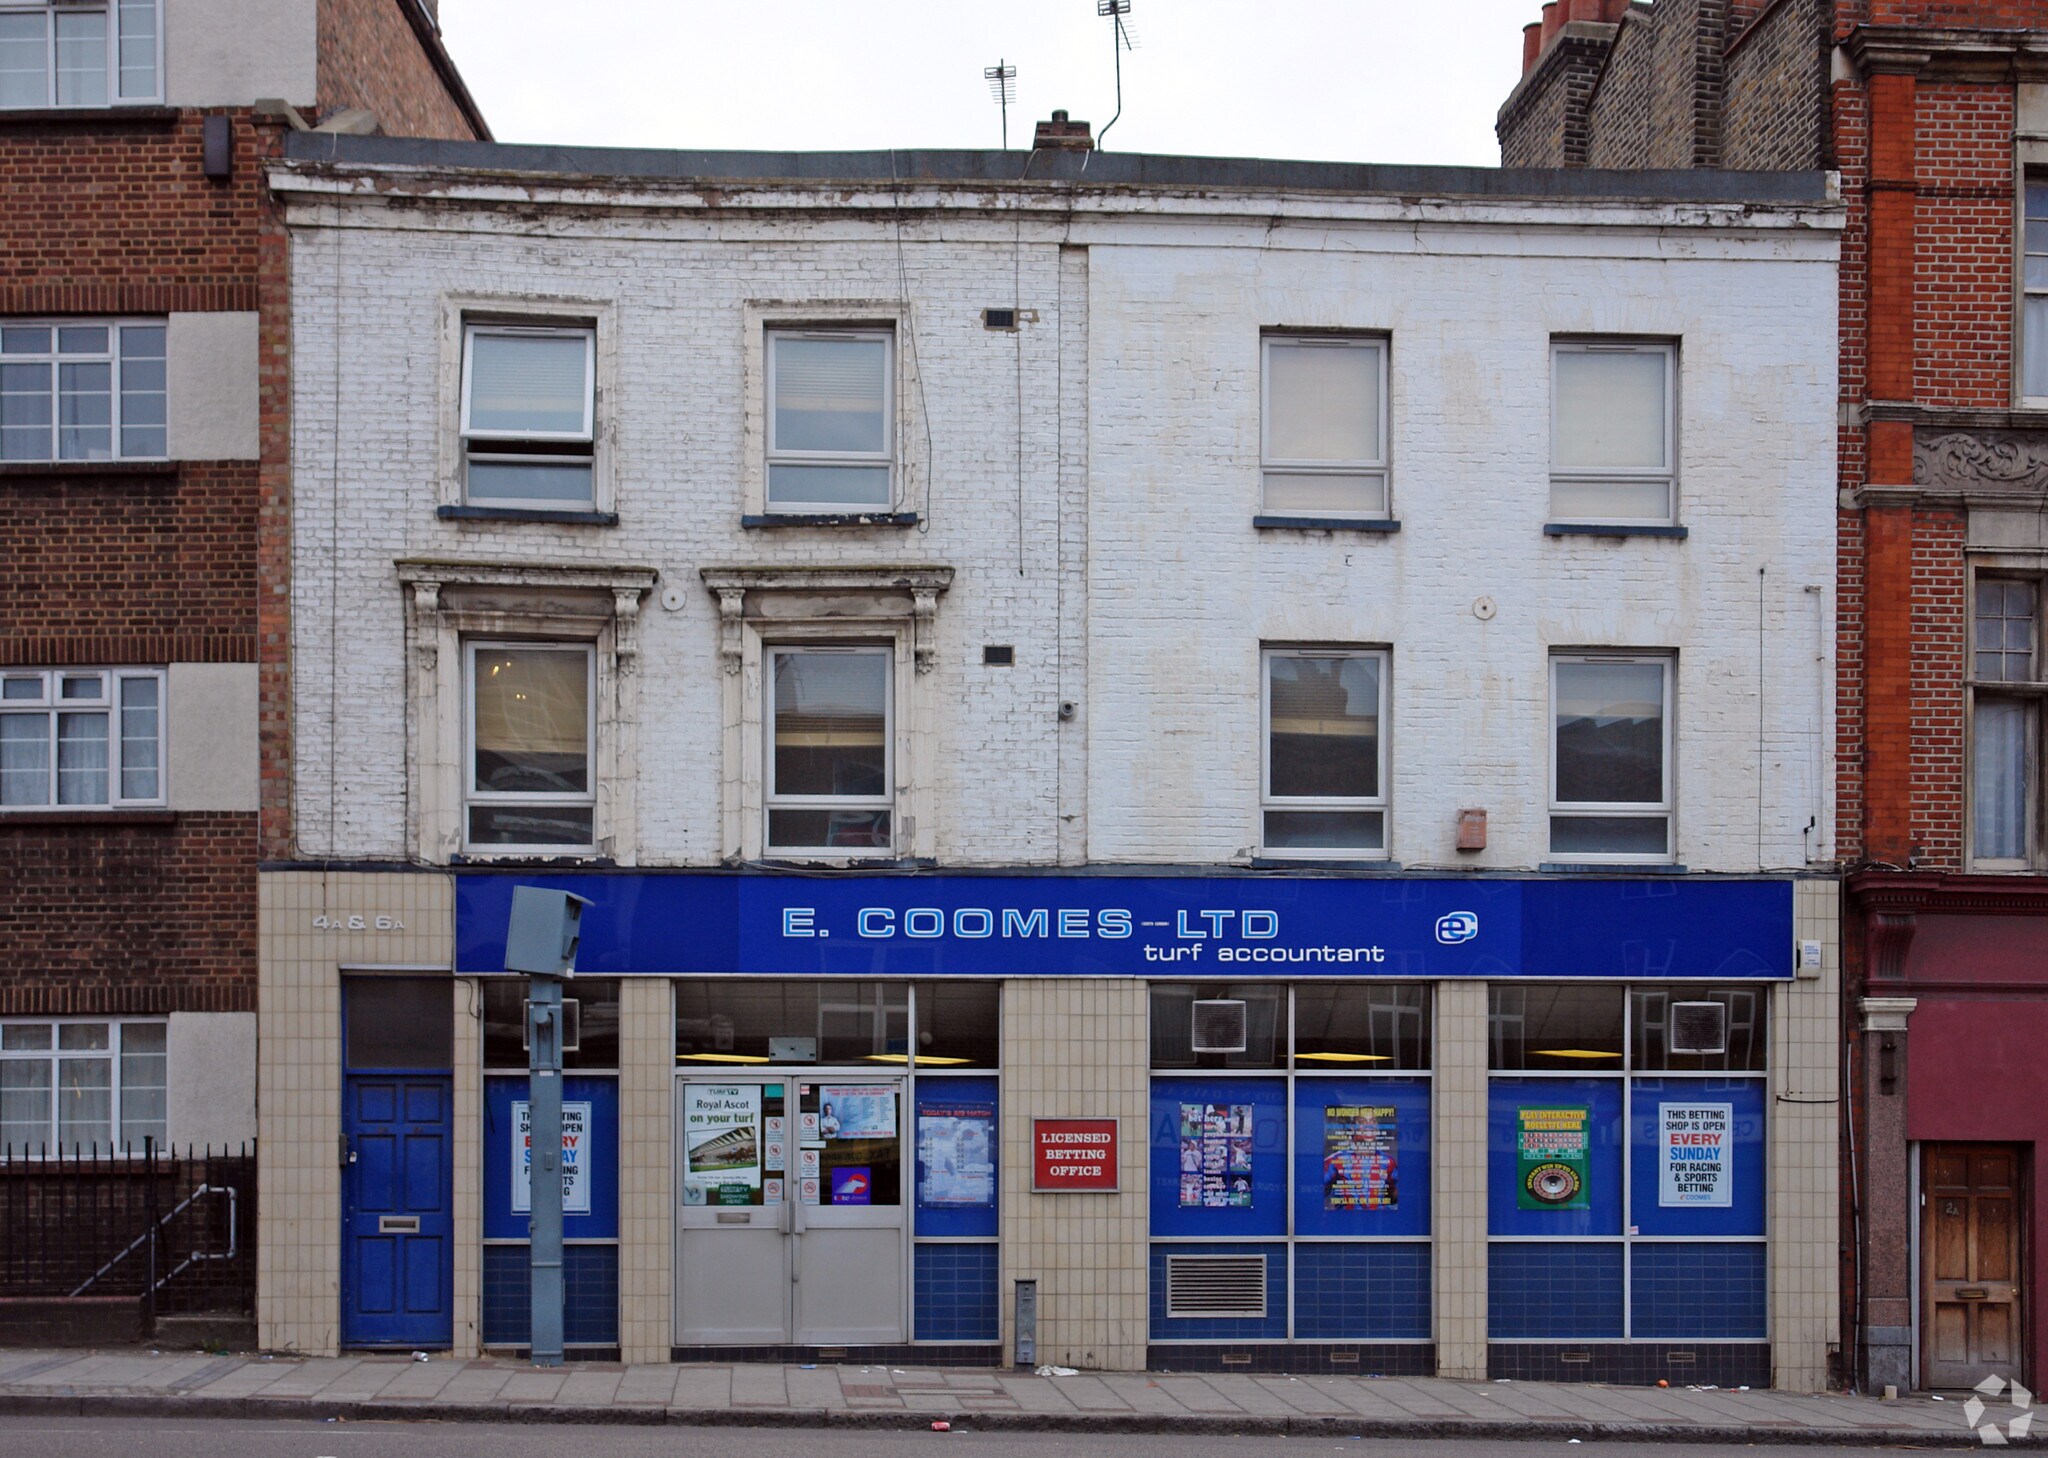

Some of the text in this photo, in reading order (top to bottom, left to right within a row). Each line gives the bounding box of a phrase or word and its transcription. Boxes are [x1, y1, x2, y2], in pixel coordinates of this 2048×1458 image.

[312, 914, 405, 929] 4A & 6A
[783, 908, 1279, 939] E. COOMES LTD
[1144, 944, 1385, 962] turf accountant
[696, 1100, 750, 1111] Royal Ascot
[690, 1112, 755, 1125] on your turf
[1667, 1110, 1725, 1119] THIS BETTING
[1666, 1121, 1689, 1131] SHOP
[1691, 1121, 1700, 1131] IS
[1703, 1121, 1726, 1131] OPEN
[1041, 1133, 1111, 1143] LICENSED
[1670, 1133, 1722, 1145] EVERY
[1045, 1149, 1107, 1159] BETTING
[1670, 1147, 1721, 1160] SUNDAY
[1050, 1166, 1102, 1176] OFFICE
[1670, 1163, 1722, 1172] FOR RACING
[1674, 1173, 1718, 1182] & SPORTS
[1677, 1183, 1714, 1192] BETTING
